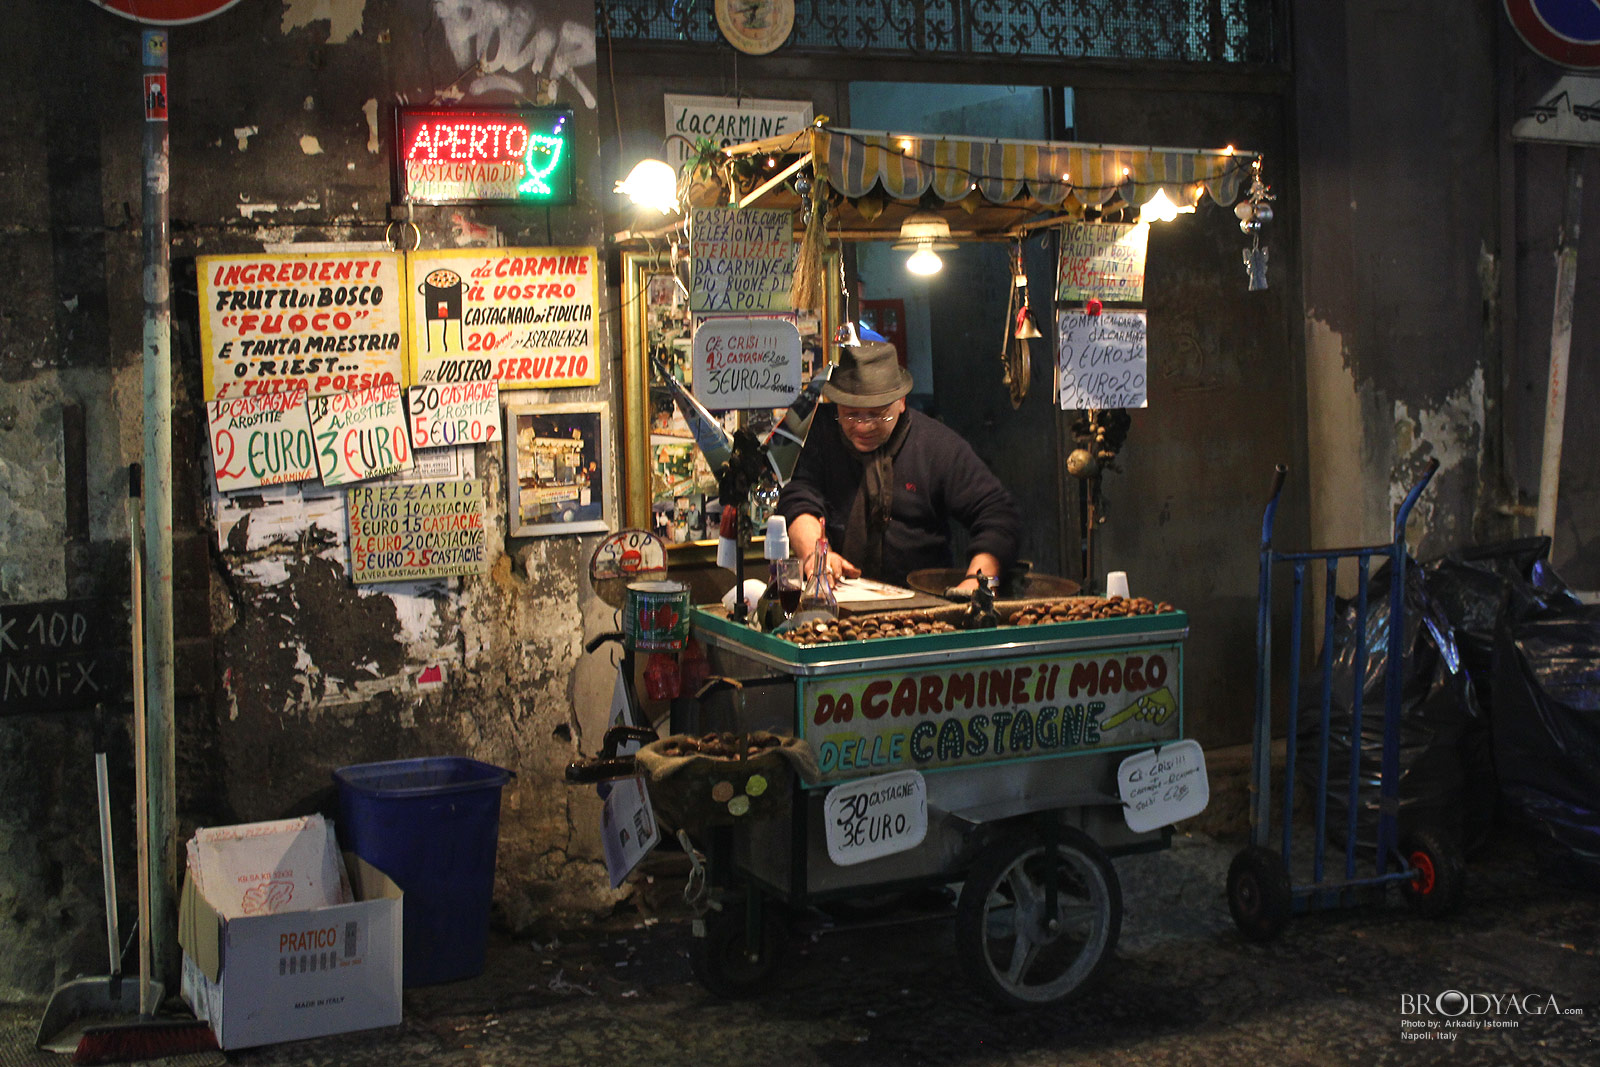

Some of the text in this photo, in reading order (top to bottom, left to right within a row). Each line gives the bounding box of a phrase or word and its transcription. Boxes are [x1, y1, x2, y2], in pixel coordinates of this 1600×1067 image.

[702, 114, 789, 137] CARMINE
[408, 124, 528, 159] APERTO
[693, 225, 784, 243] SELEZIONATE
[693, 241, 790, 260] STERILIZZATE
[213, 260, 382, 287] INGREDIENTI
[471, 256, 590, 279] da CARMINE
[695, 258, 715, 276] DA
[717, 258, 783, 277] CARMINE
[215, 289, 299, 312] FRUTTI
[317, 286, 384, 308] BOSCO
[492, 283, 577, 302] VOSTRO
[701, 291, 773, 312] NAPOLI
[464, 307, 535, 326] CASTAGNAIO
[544, 304, 592, 324] FIDUCIA
[218, 333, 400, 359] E TANTA MAESTRIA
[467, 332, 496, 352] 20
[523, 329, 589, 349] ESPERIENZA
[727, 335, 759, 350] CRISI
[435, 359, 492, 383] VOSTRO
[492, 354, 589, 381] SERVIZIO
[1060, 345, 1074, 373] 2
[1079, 344, 1123, 369] EURO
[314, 372, 396, 394] POESIA
[707, 370, 721, 395] 3
[1062, 370, 1146, 405] 3 EURO 20
[211, 388, 304, 424] 10 CASTAGNE
[312, 383, 401, 425] 18 CASTAGNE
[411, 381, 497, 416] 30 CASTAGNE
[1075, 392, 1144, 411] CASTAGNE
[228, 410, 286, 430] AROSTITE
[414, 416, 483, 447] 5 EURO
[215, 429, 313, 480] 2 EURO
[317, 425, 408, 479] 3 EURO
[352, 482, 474, 506] PREZZARIO
[351, 504, 360, 521] 2
[360, 502, 398, 520] EURO
[403, 500, 421, 519] 10
[351, 520, 362, 538] 3
[361, 519, 398, 537] EURO
[402, 517, 422, 534] 15
[353, 537, 366, 554] 4
[366, 535, 402, 554] EURO
[402, 534, 424, 552] 20
[603, 533, 653, 560] STOP
[355, 552, 367, 572] 5
[366, 551, 404, 570] EURO
[403, 549, 432, 568] 25
[355, 572, 367, 582] LA
[367, 569, 387, 580] VERA
[3, 660, 100, 702] NOFX
[813, 692, 855, 726] DA
[860, 666, 1033, 721] CARMINE
[1067, 654, 1169, 704] MAGO
[819, 700, 1107, 775] DELLE CASTAGNE
[837, 781, 915, 826] 30 CASTAGNE
[840, 821, 854, 849] 3
[280, 927, 337, 953] PRATICO
